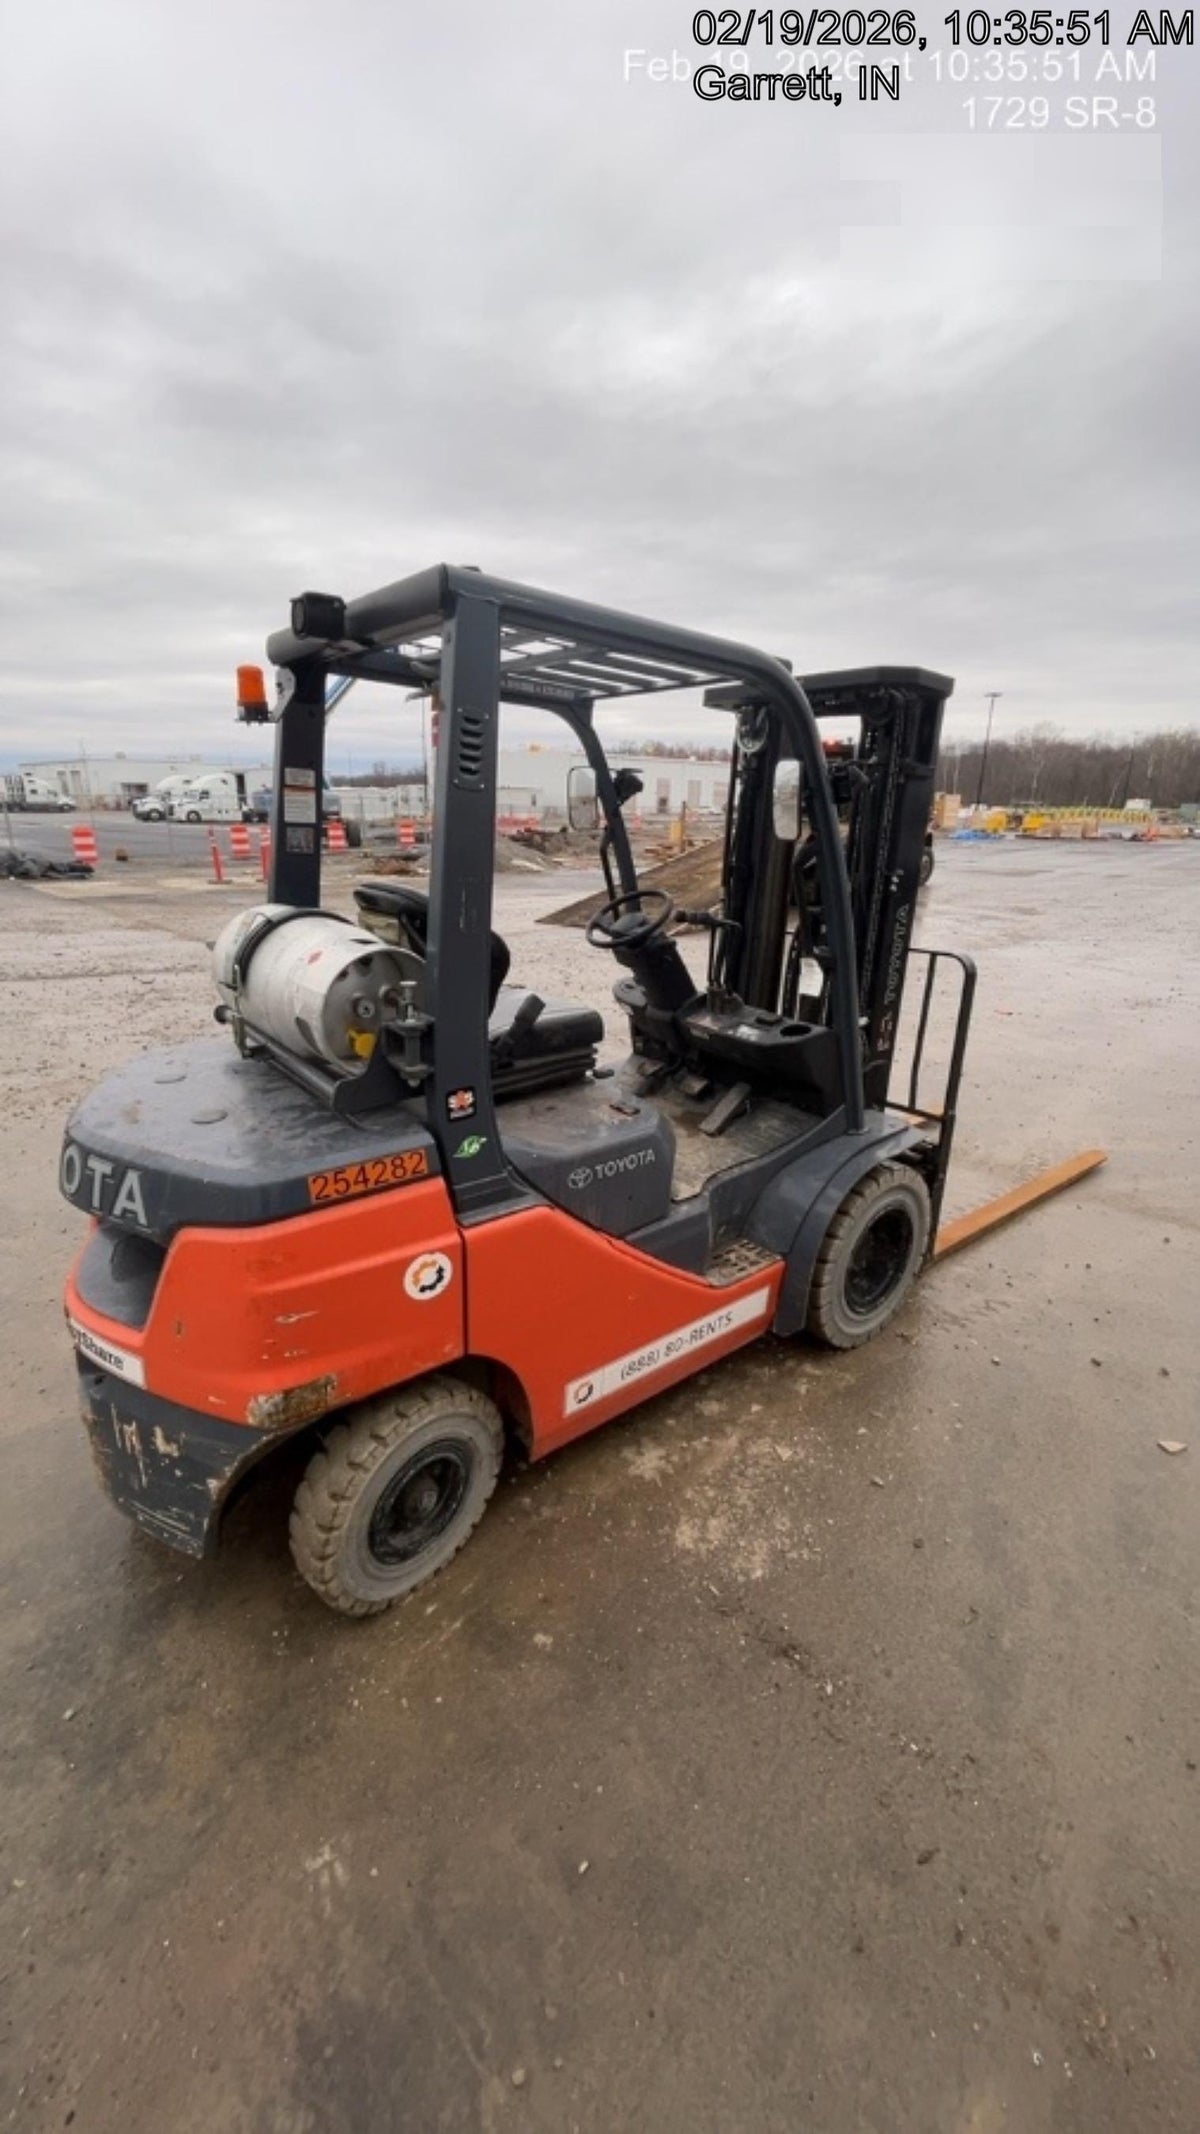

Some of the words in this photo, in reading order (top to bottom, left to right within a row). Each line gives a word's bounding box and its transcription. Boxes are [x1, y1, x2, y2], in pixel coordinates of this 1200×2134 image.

[312, 1151, 426, 1200] 254282
[595, 1149, 655, 1180] TOYOTA
[620, 1349, 660, 1381] (888)
